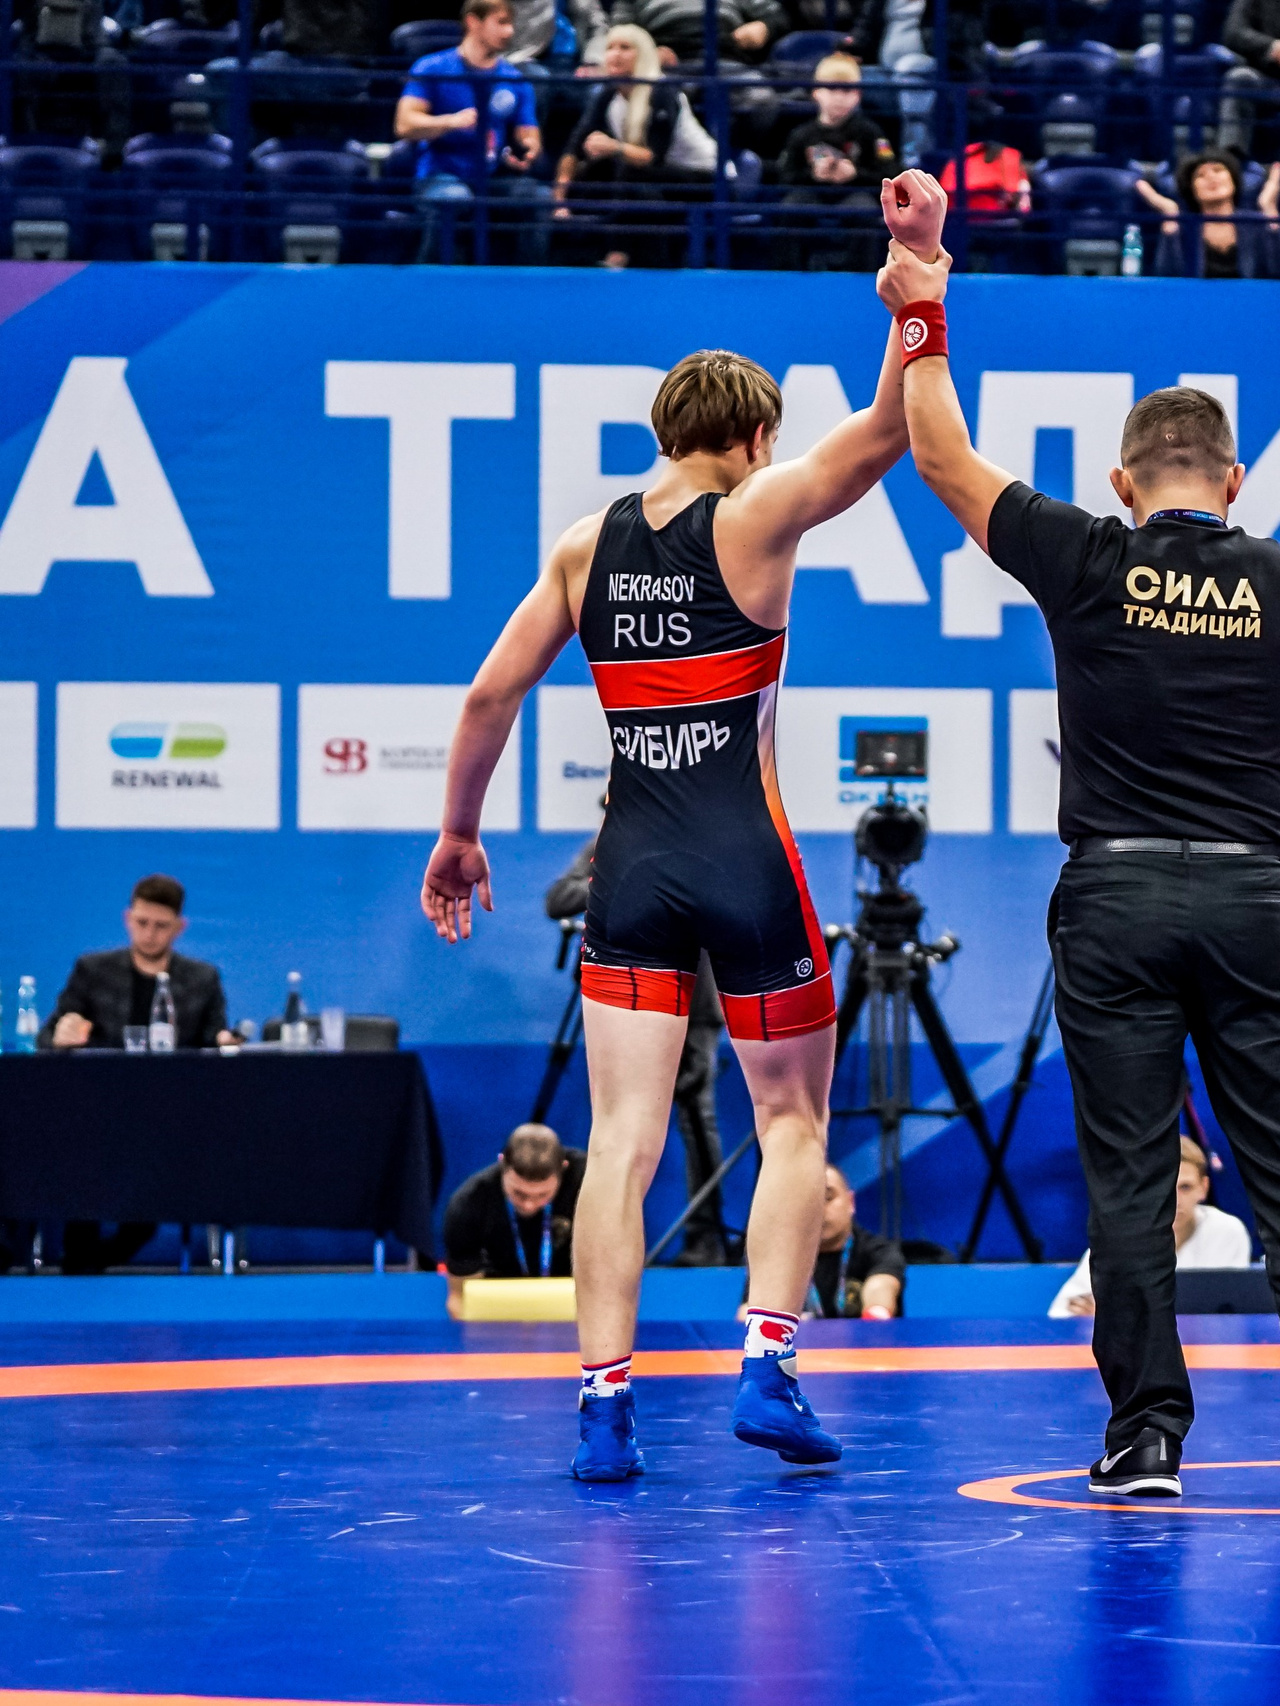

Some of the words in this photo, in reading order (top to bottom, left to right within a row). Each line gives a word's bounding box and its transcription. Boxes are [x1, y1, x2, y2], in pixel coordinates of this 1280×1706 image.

[608, 573, 695, 603] NEKRASOV
[1126, 565, 1262, 612] СИЛА
[614, 612, 693, 649] RUS
[1123, 603, 1262, 639] ТРАДИЦИЙ
[613, 720, 731, 770] СИБИРЬ
[111, 769, 222, 788] RENEWAL
